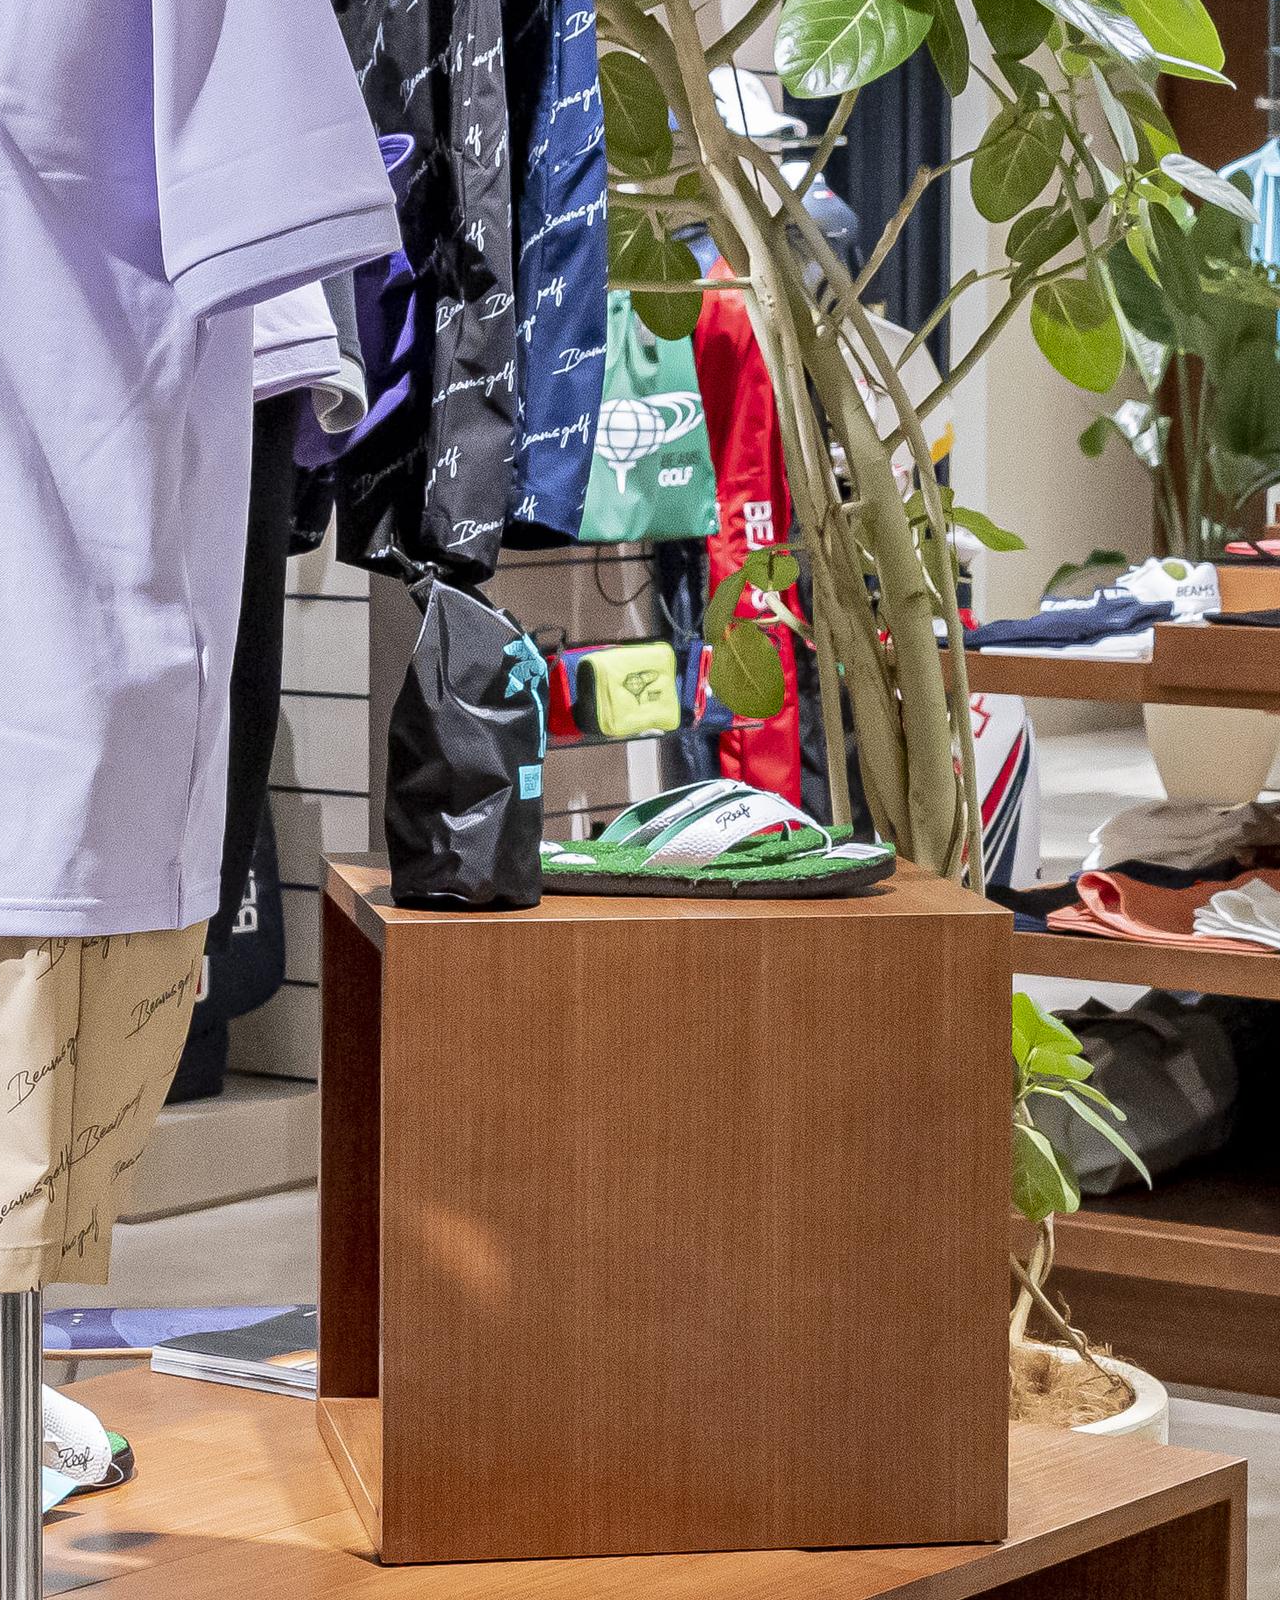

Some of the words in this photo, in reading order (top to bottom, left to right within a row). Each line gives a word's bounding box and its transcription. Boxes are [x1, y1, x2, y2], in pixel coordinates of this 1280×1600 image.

[658, 466, 694, 487] GOLF
[1176, 584, 1216, 599] BEAMS
[58, 1446, 95, 1471] Reef
